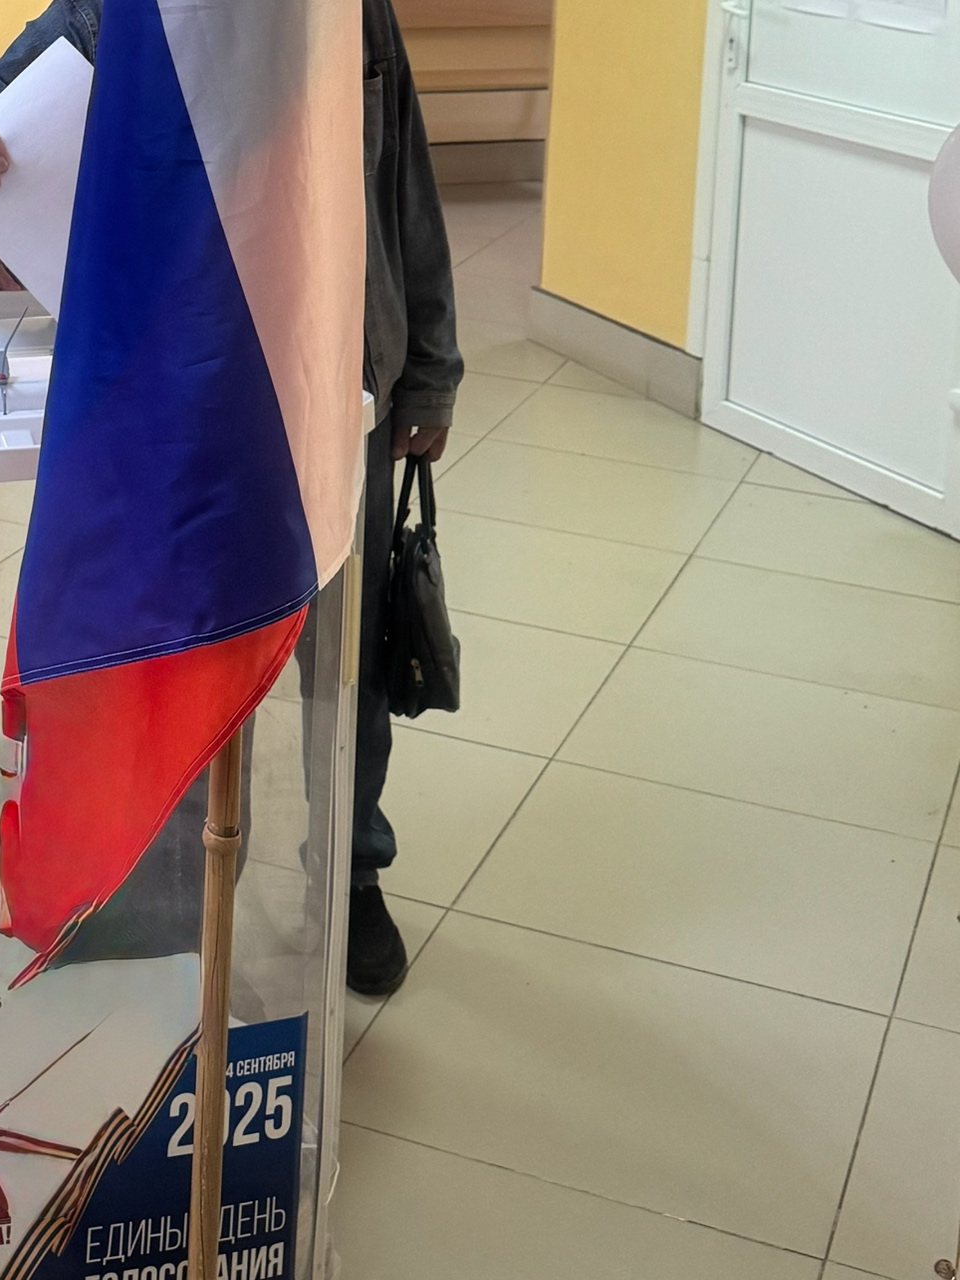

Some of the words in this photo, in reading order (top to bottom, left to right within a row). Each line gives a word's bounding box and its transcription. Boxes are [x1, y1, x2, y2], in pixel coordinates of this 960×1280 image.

[236, 1051, 295, 1076] СЕНТЯБРЯ
[167, 1075, 293, 1158] 225
[85, 1212, 189, 1266] ЕДИНЫ
[218, 1196, 286, 1244] ДЕНЬ
